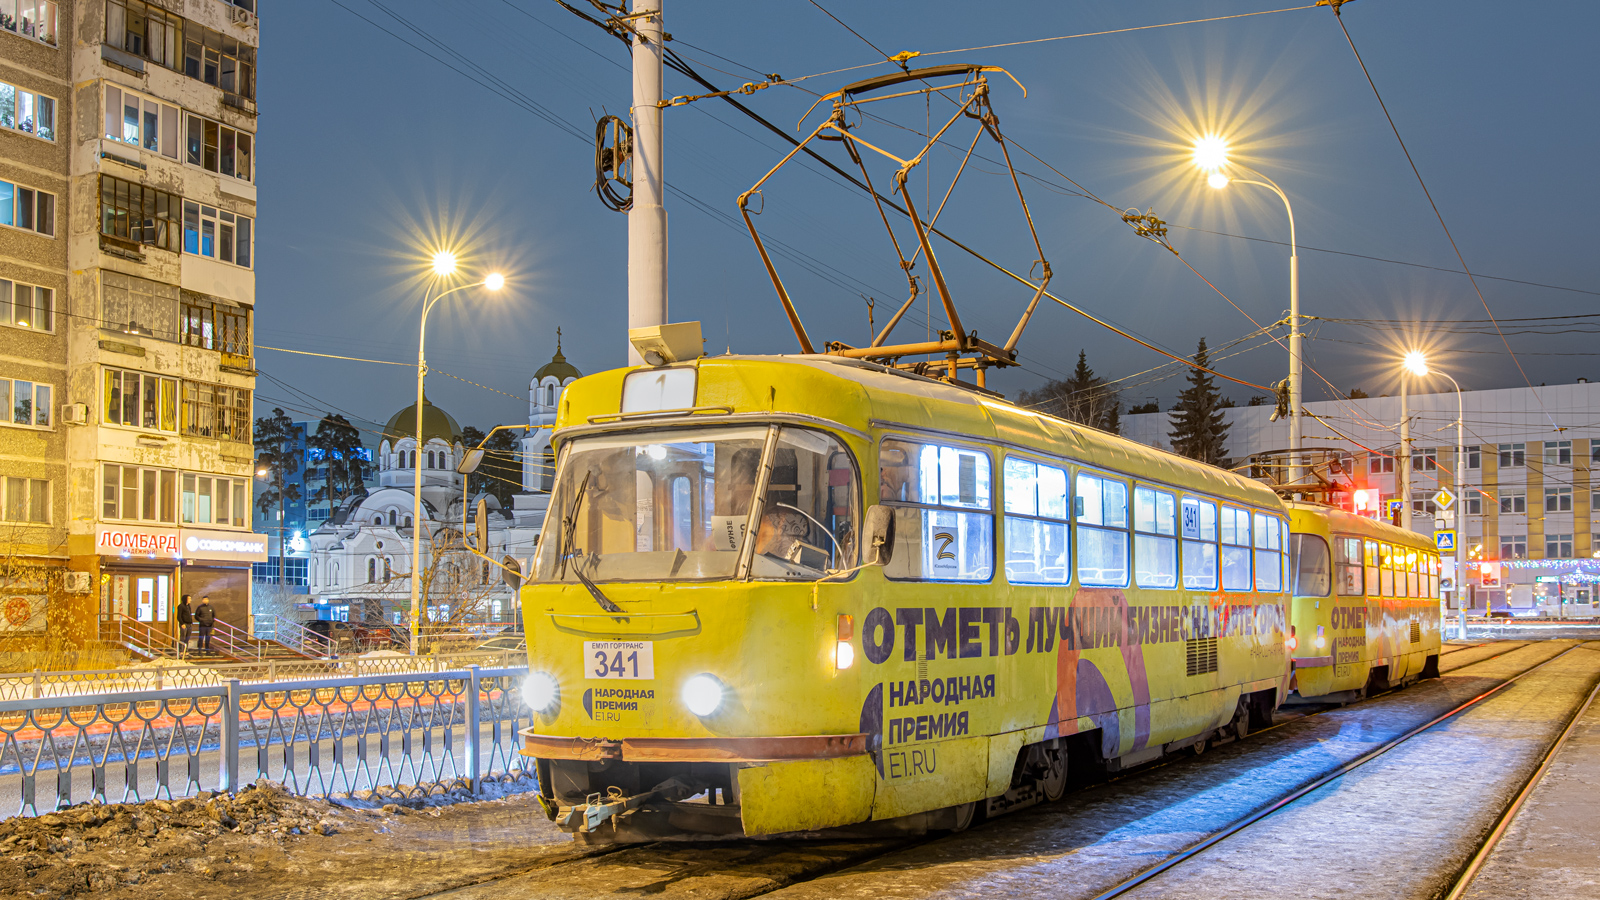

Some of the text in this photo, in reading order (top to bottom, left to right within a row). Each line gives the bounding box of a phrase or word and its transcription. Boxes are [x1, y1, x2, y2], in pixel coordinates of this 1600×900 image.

[1185, 506, 1197, 528] 341
[100, 532, 177, 553] ЛОМБАРД
[726, 520, 737, 549] ФРУНЗЕ
[862, 606, 1020, 665] ОТМЕТЬ
[1026, 595, 1122, 654] ЛУЧШИЙ
[1127, 605, 1189, 646] БИЗНЕС
[1191, 605, 1210, 639] НА
[1213, 605, 1252, 638] КАРТЕ
[591, 642, 644, 650] ЕМУП ГОРТРАНС
[1338, 636, 1366, 648] НАРОДНАЯ
[594, 650, 639, 678] 341
[1337, 651, 1359, 663] ПРЕМИЯ
[595, 688, 655, 699] НАРОДНАЯ
[889, 674, 996, 707] НАРОДНАЯ
[595, 700, 638, 711] ПРЕМИЯ
[595, 711, 621, 722] E1.RU
[889, 710, 969, 745] ПРЕМИЯ
[889, 748, 937, 779] E1.RU
